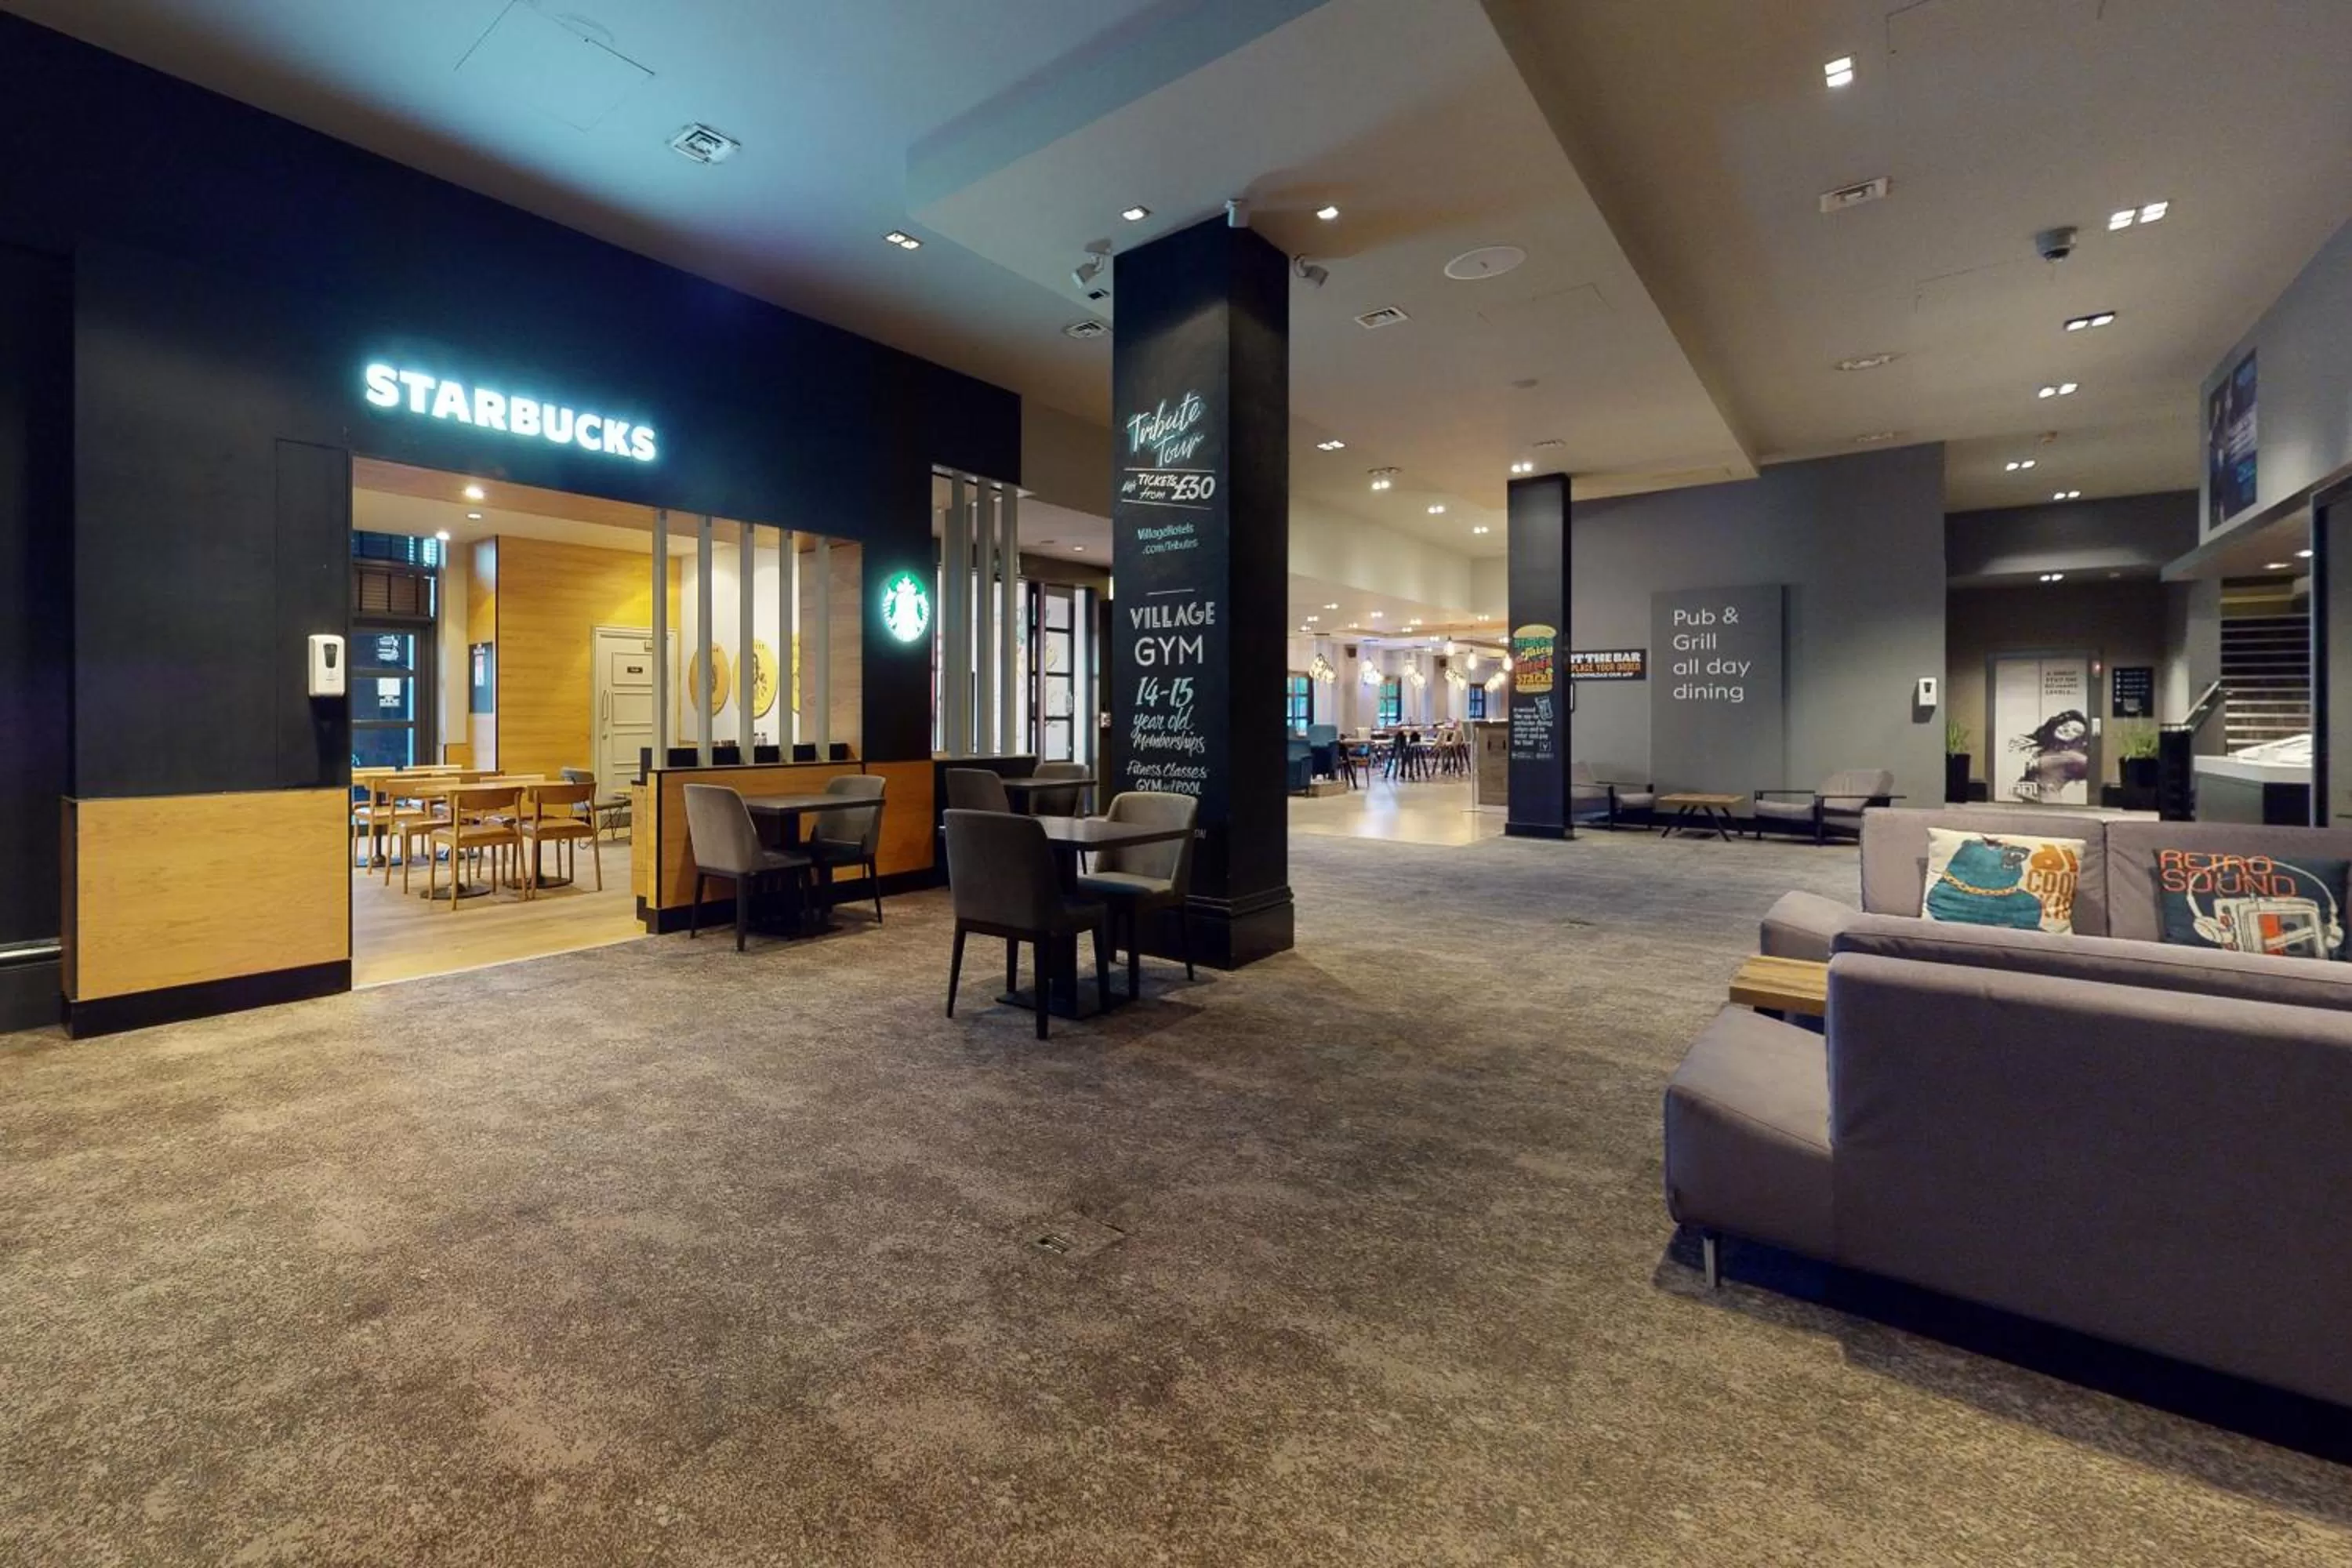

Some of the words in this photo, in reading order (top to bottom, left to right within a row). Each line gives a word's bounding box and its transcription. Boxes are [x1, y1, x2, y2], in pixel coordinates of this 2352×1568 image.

[365, 363, 657, 462] STARBUCKS
[1127, 392, 1202, 452] Tribute
[1154, 434, 1204, 467] Tour
[1139, 486, 1166, 499] from
[1171, 474, 1215, 501] £30
[1130, 601, 1215, 630] VILLAGE
[1673, 608, 1716, 626] Pub
[1722, 606, 1739, 625] &
[1134, 634, 1203, 666] GYM
[1673, 633, 1717, 651] Grill
[1585, 653, 1613, 663] THE
[1613, 652, 1641, 662] BAR
[1673, 659, 1699, 675] all
[1706, 658, 1751, 678] day
[1135, 676, 1194, 707] 14-15
[1673, 683, 1744, 703] dining
[1130, 713, 1165, 738] year
[1167, 705, 1195, 732] old
[1135, 779, 1162, 791] GYM
[2160, 850, 2273, 876] RETRO
[2162, 868, 2296, 898] SOUND
